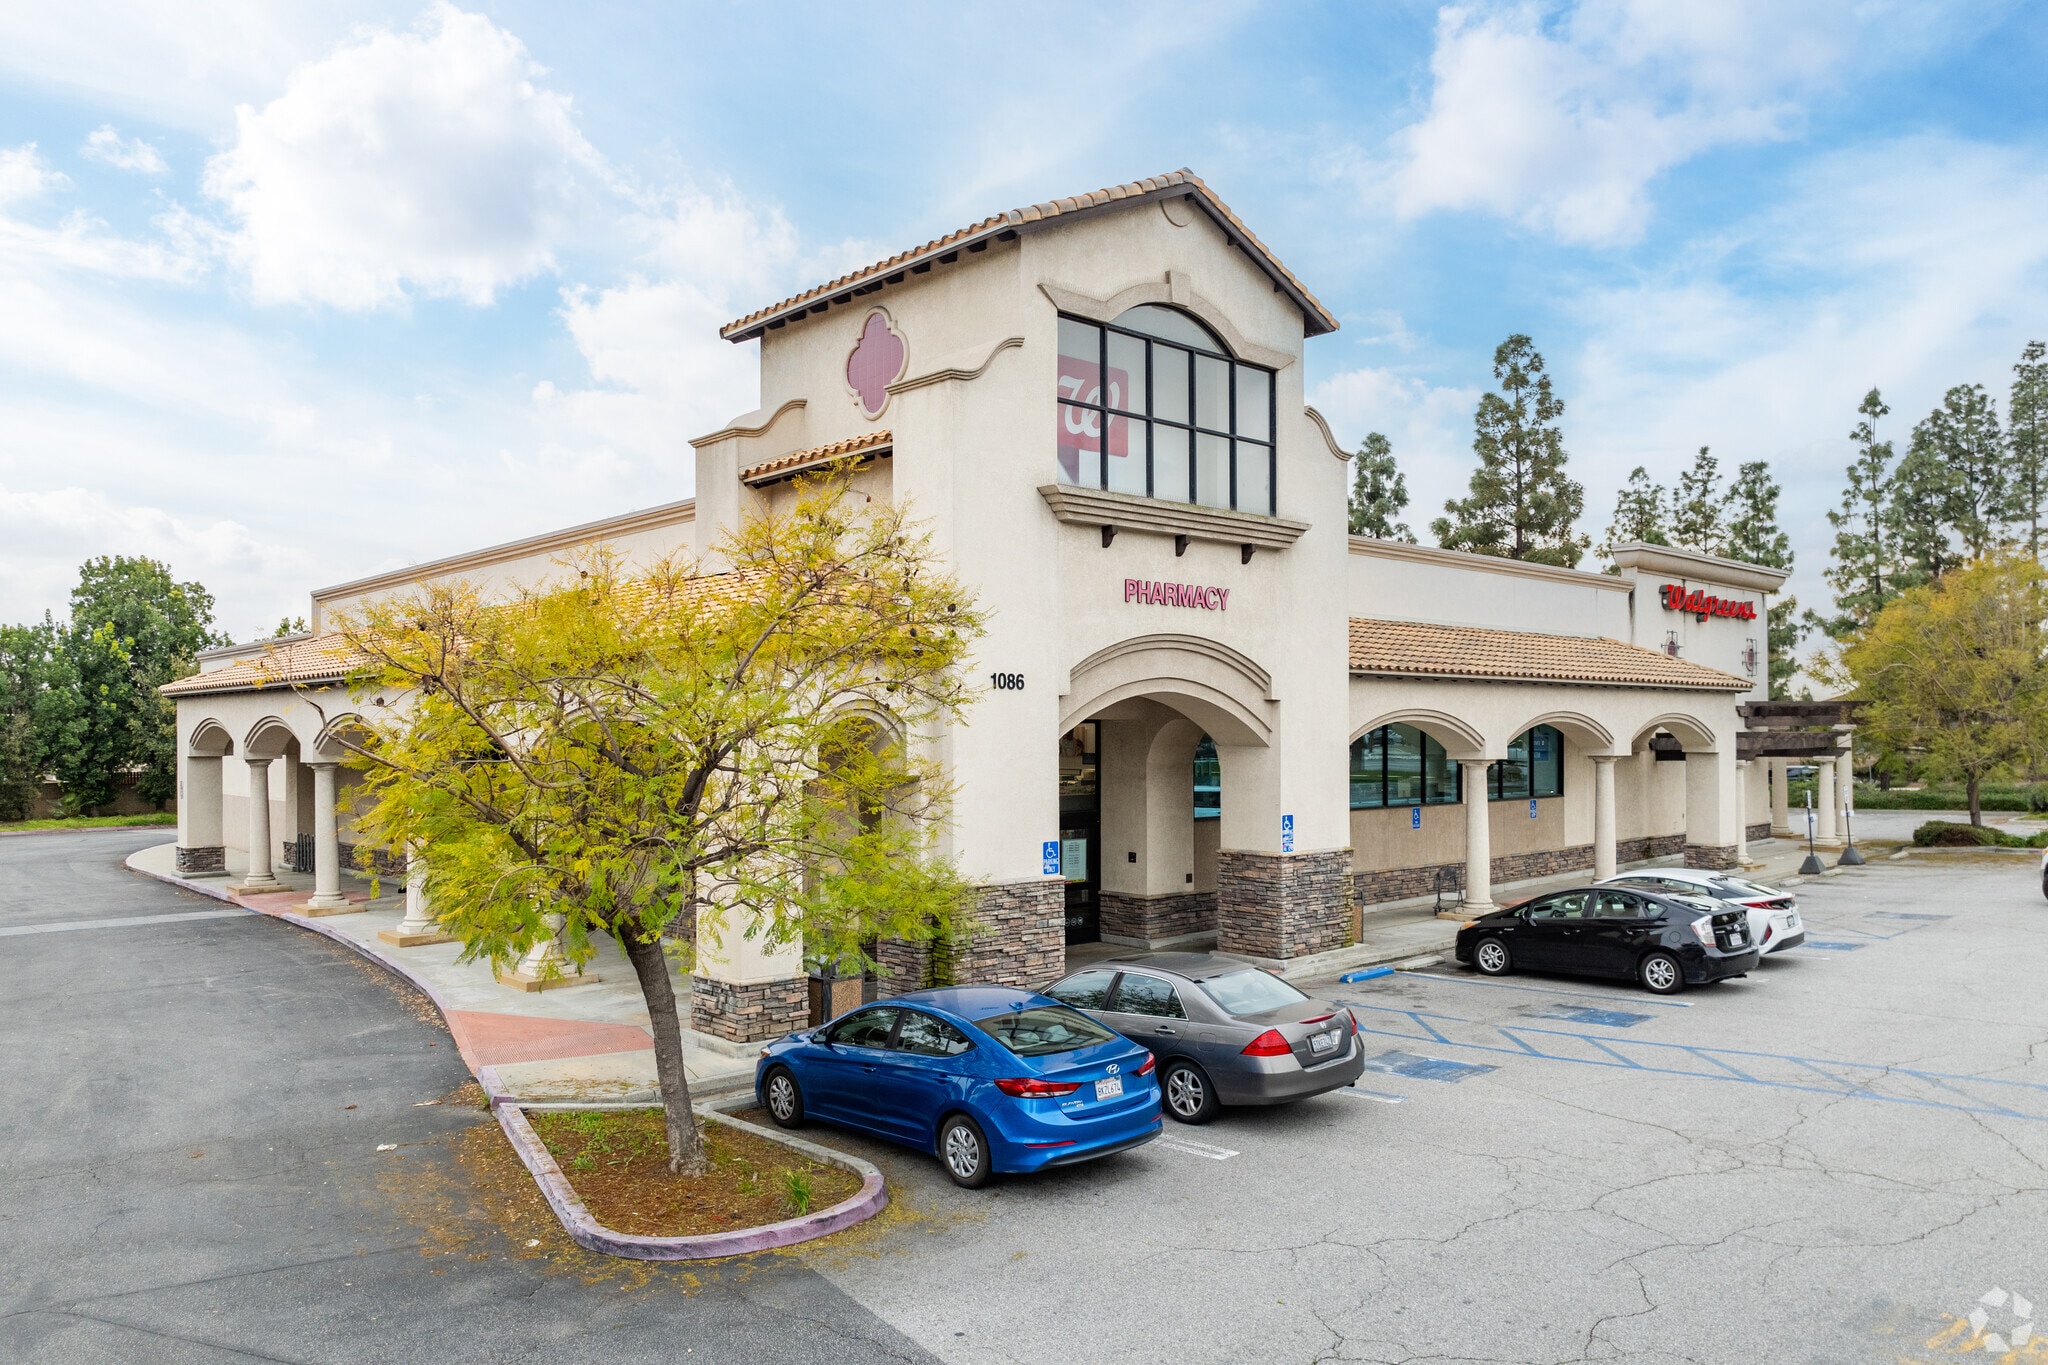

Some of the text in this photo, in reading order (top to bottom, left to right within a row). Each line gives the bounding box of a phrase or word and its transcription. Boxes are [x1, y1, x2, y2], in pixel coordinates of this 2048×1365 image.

[1125, 579, 1230, 611] PHARMACY
[1661, 583, 1758, 623] Walgreens
[990, 672, 1025, 691] 1086
